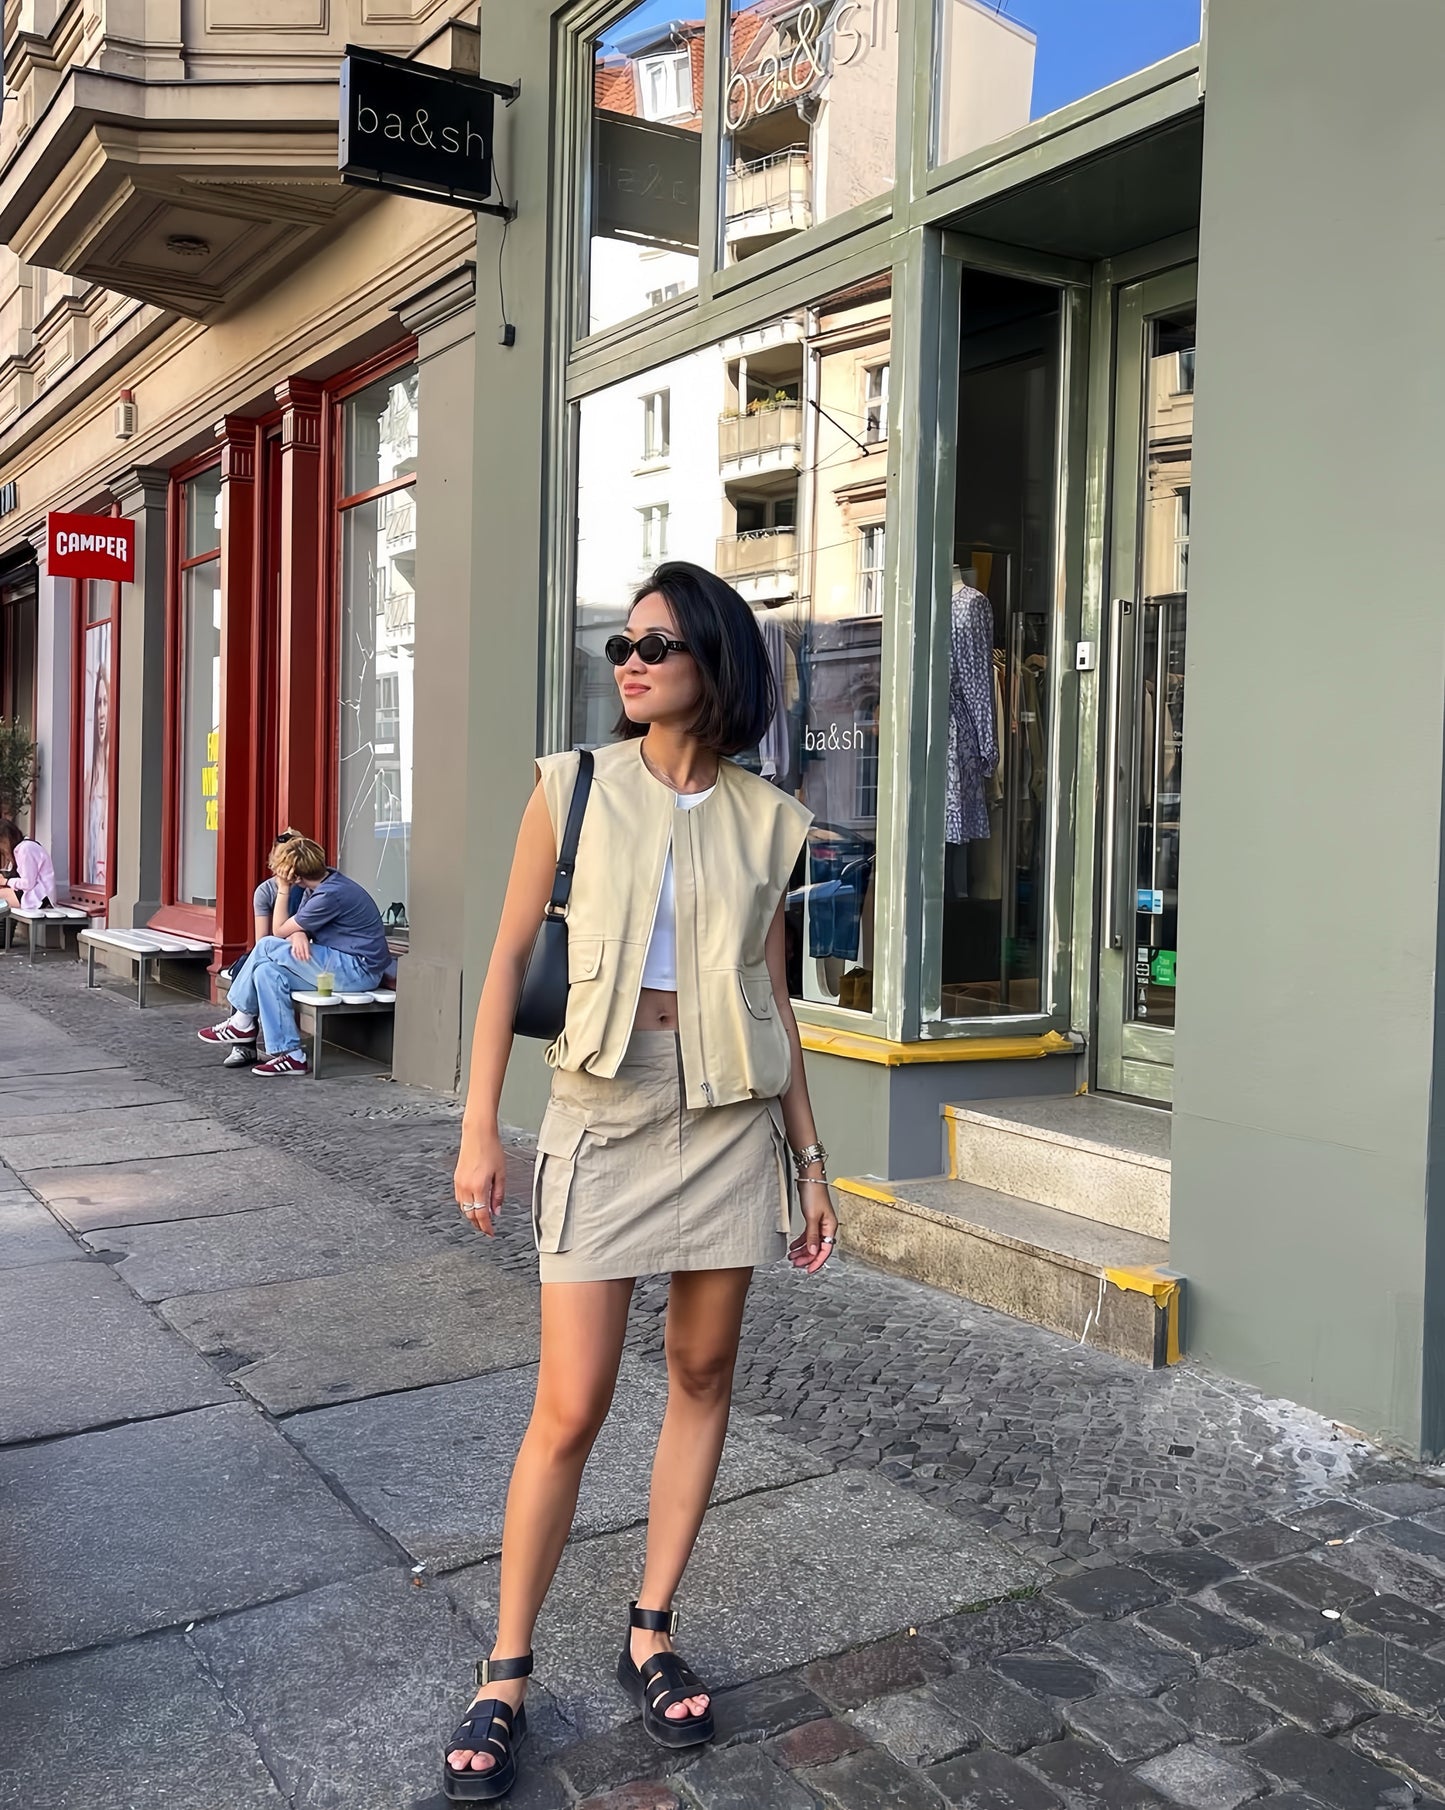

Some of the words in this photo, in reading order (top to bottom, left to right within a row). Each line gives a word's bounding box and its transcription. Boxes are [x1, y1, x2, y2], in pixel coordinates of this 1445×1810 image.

[357, 94, 484, 160] ba&sh
[56, 531, 127, 563] CAMPER
[805, 722, 864, 751] ba&sh
